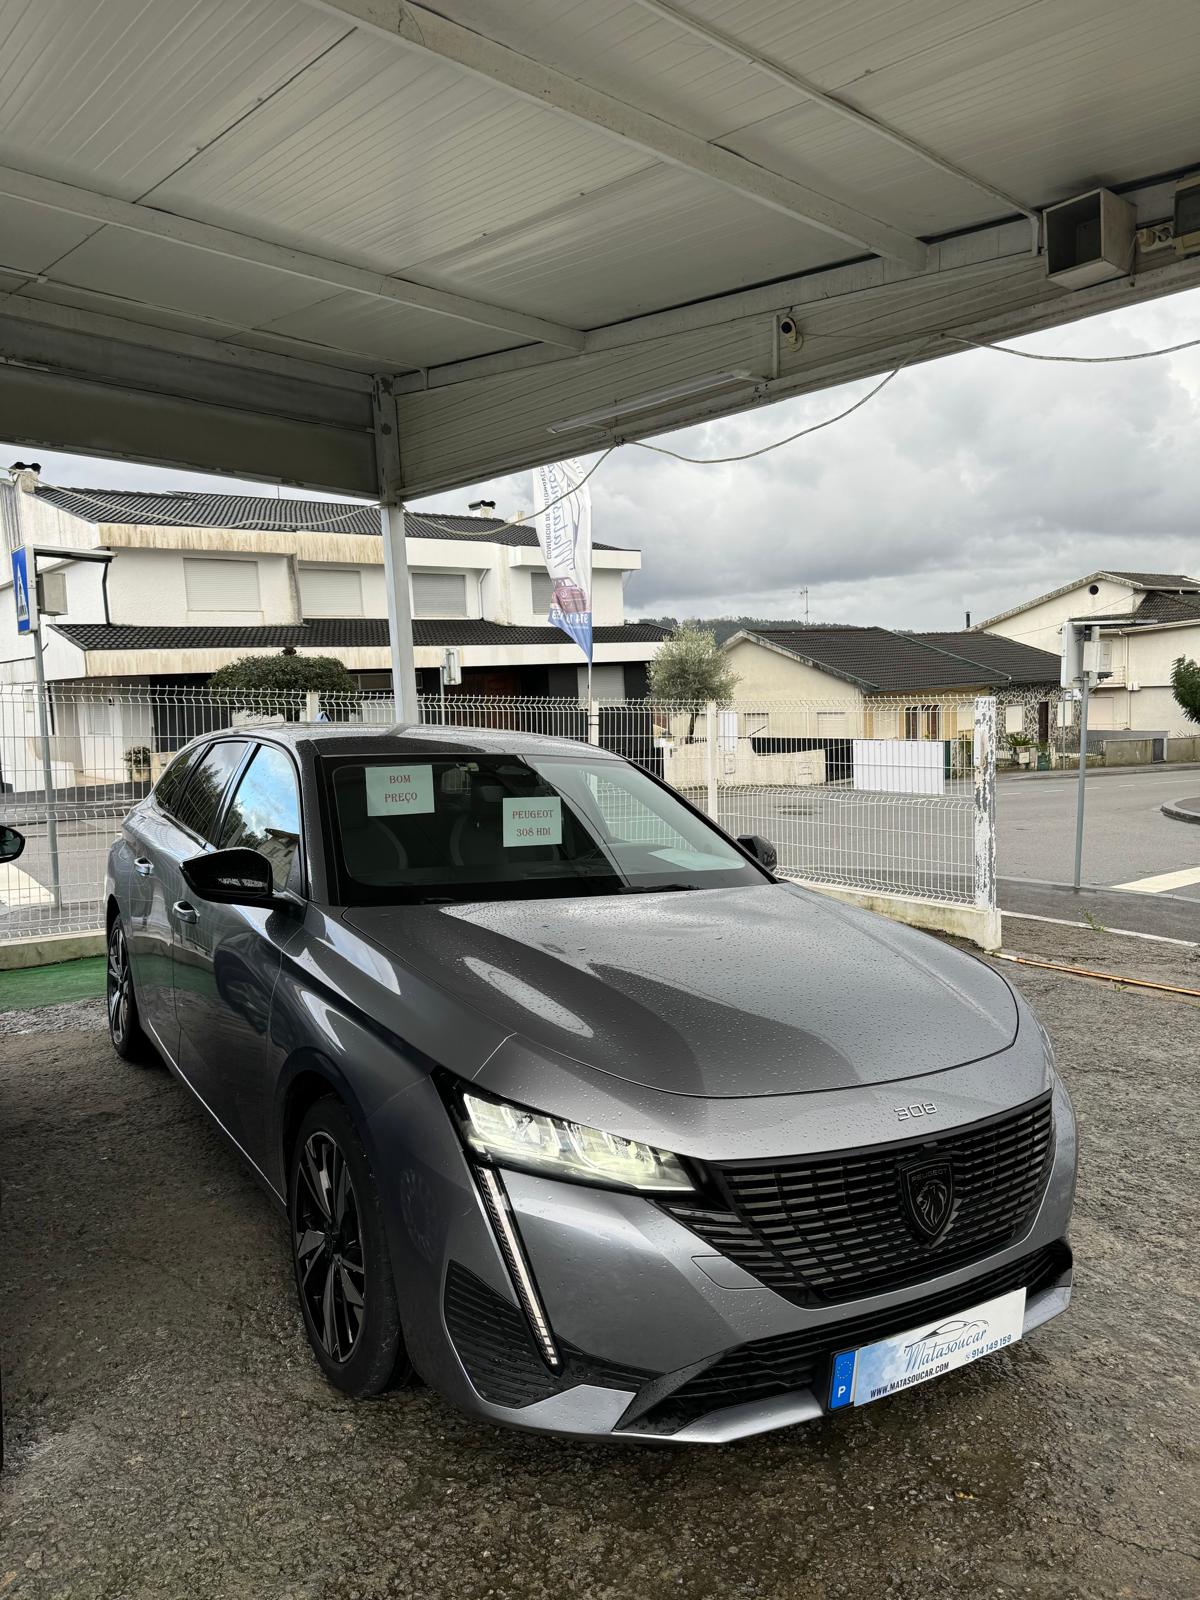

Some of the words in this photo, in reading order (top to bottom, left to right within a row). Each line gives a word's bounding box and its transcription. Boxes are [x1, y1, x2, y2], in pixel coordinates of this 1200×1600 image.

[389, 774, 411, 784] BOM
[384, 792, 418, 804] PREÇO
[512, 809, 553, 819] PEUGEOT
[516, 827, 534, 837] 308
[894, 1102, 938, 1121] 308
[911, 1168, 948, 1182] PEUGEOT
[904, 1329, 987, 1372] Matasoucar
[971, 1346, 984, 1359] 914
[985, 1340, 999, 1353] 149
[1000, 1334, 1012, 1346] 159
[870, 1361, 950, 1399] WWW.MATASOUCAR.COM
[838, 1385, 846, 1398] P
